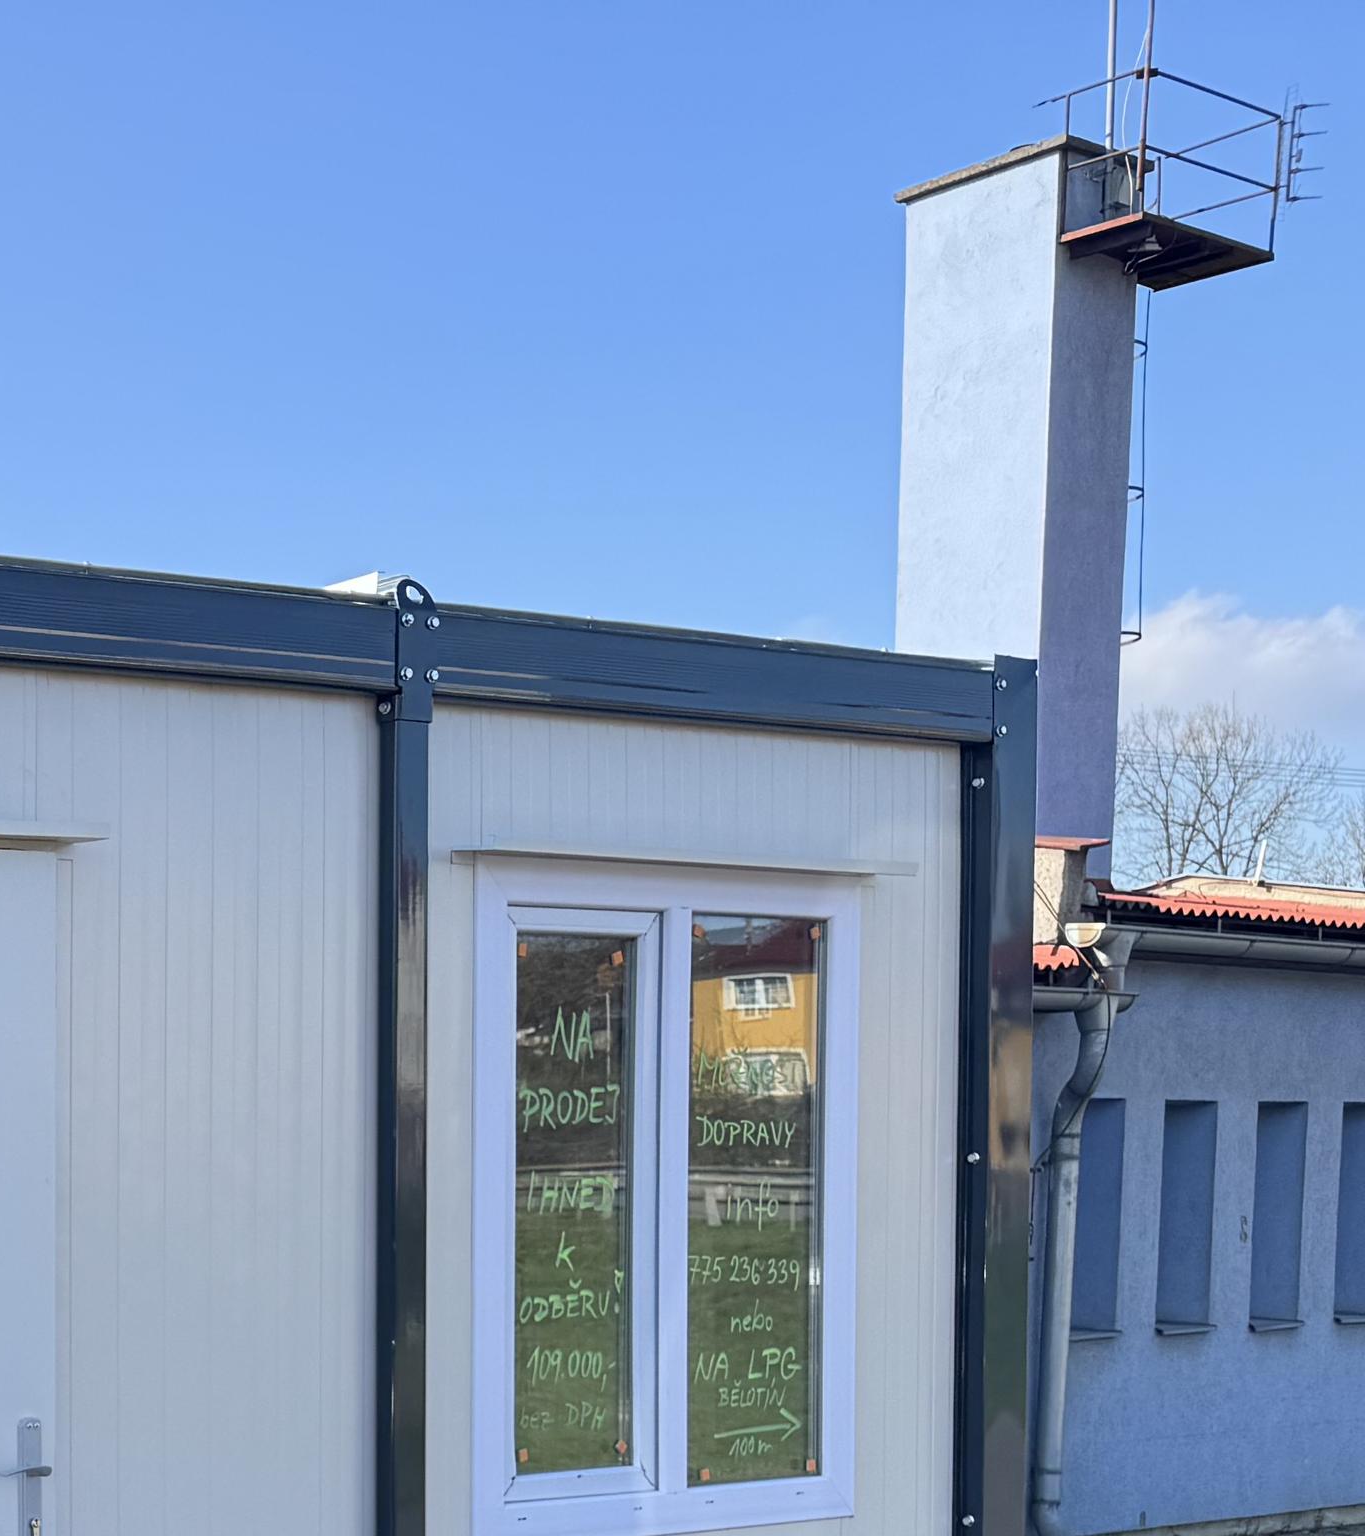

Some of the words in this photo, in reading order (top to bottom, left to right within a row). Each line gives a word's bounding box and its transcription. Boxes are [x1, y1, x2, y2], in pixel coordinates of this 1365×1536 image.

[550, 1005, 594, 1063] NA
[518, 1084, 620, 1133] PRODEJ
[695, 1116, 796, 1148] DOPRAVY
[527, 1171, 615, 1216] IHNED
[727, 1178, 779, 1232] info
[731, 1299, 773, 1333] nebo
[694, 1352, 729, 1384] NA
[748, 1346, 802, 1380] LPG
[565, 1401, 606, 1430] DPH
